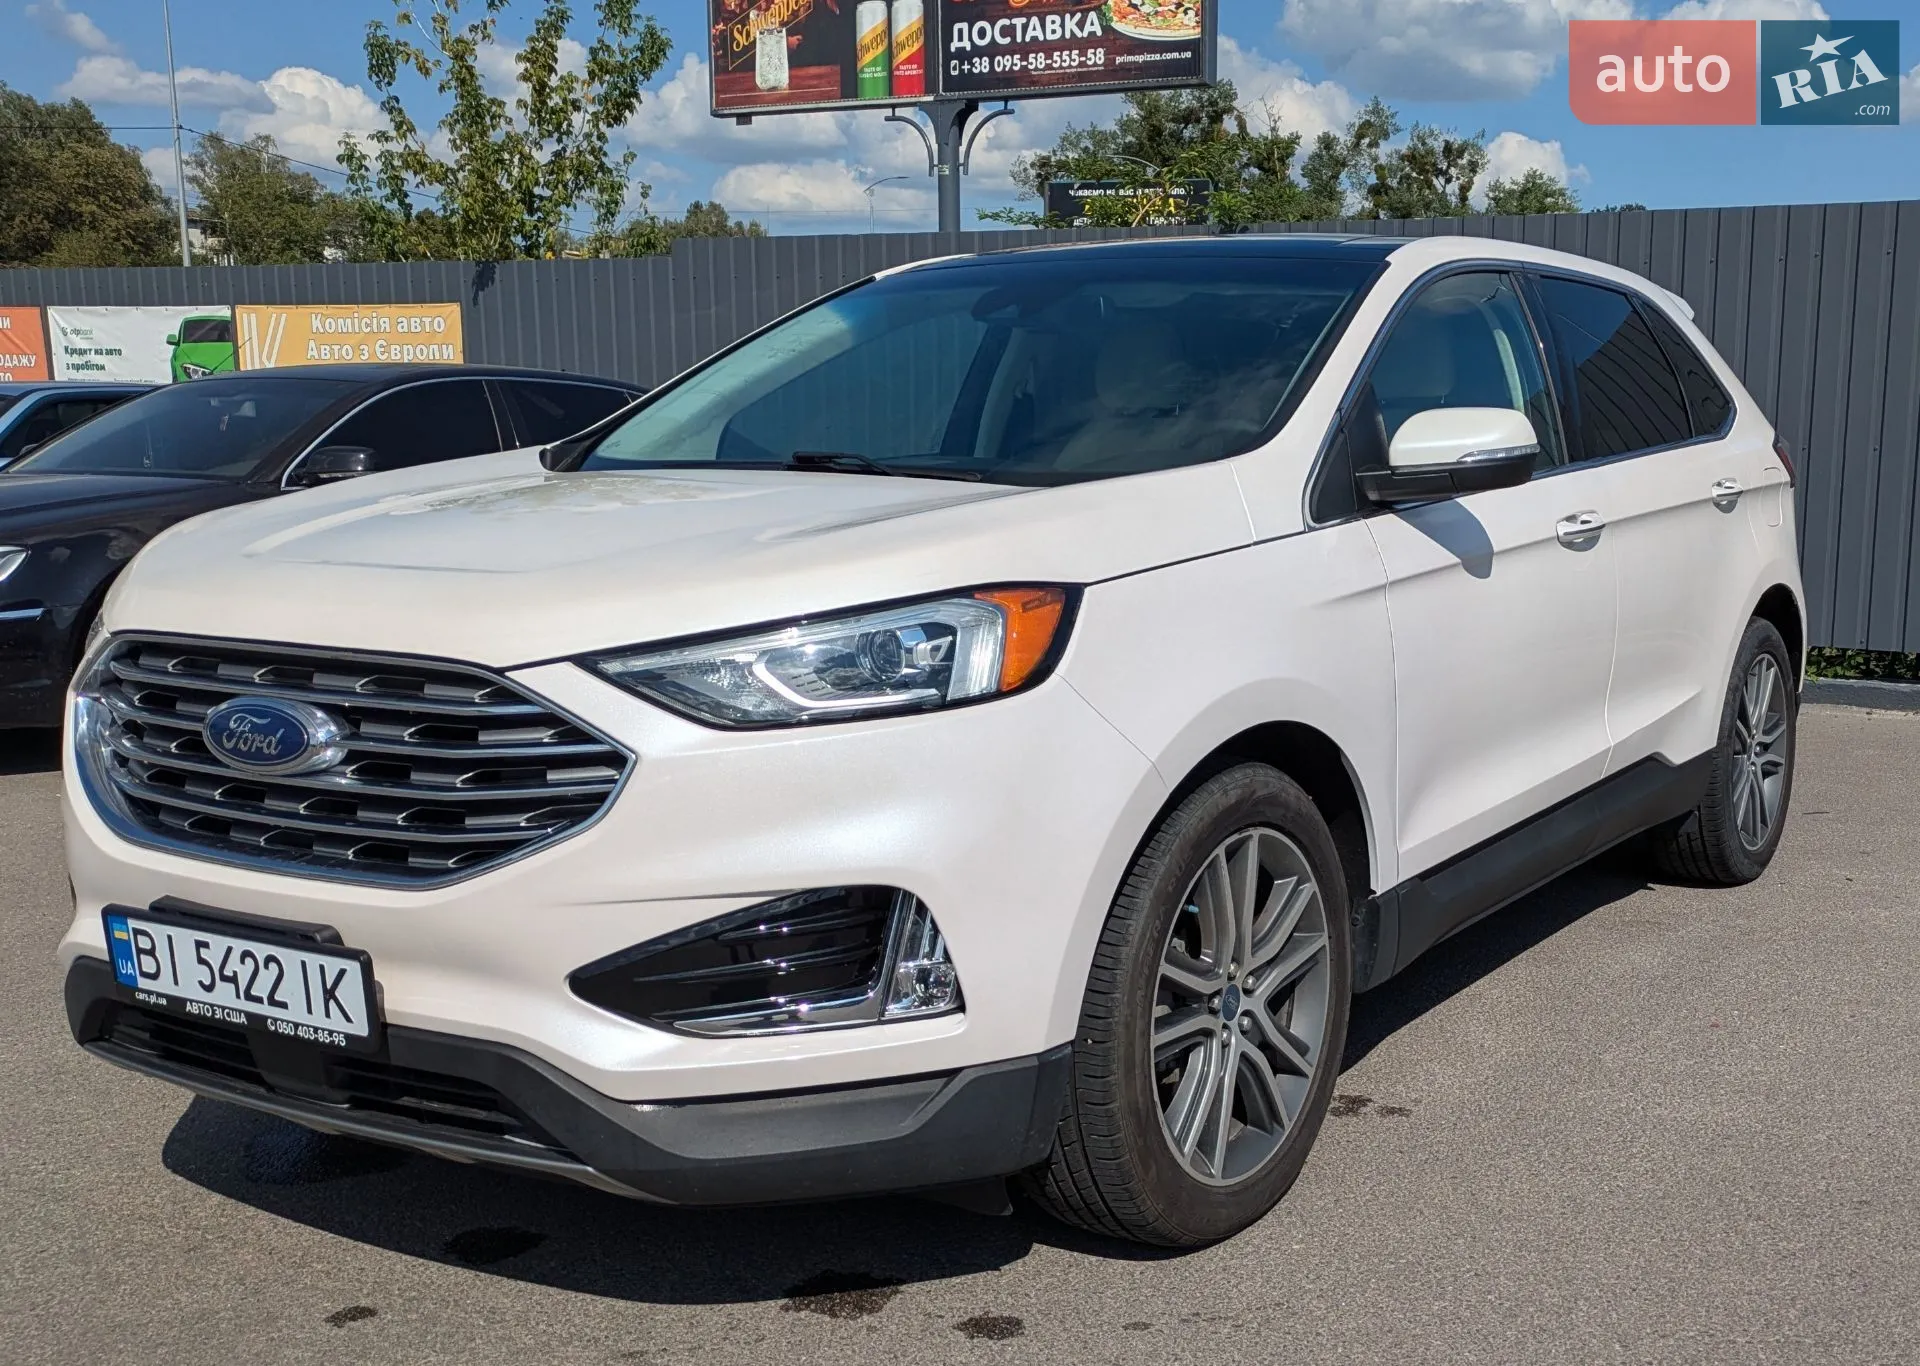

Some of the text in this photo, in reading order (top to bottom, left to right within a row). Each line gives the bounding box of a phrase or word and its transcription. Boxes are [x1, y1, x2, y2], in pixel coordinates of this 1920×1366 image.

[733, 0, 807, 52] Schweppe
[950, 11, 1103, 52] ДОСТАВКА
[961, 56, 990, 74] +38
[994, 48, 1105, 72] 095-58-555-58
[1115, 51, 1192, 65] primapizza.com.ua
[311, 312, 446, 334] Комісія авто
[64, 345, 122, 358] Кредит на авто
[307, 338, 455, 363] Авто з Європи
[66, 360, 106, 373] з пробігом
[222, 713, 285, 756] Ford
[119, 958, 135, 976] UA
[131, 926, 355, 1024] BI 5422 IK
[135, 990, 167, 1005] cars.pl.ua
[185, 1001, 248, 1025] АВТО ЗІ США
[276, 1020, 346, 1047] 050 403-85-95
